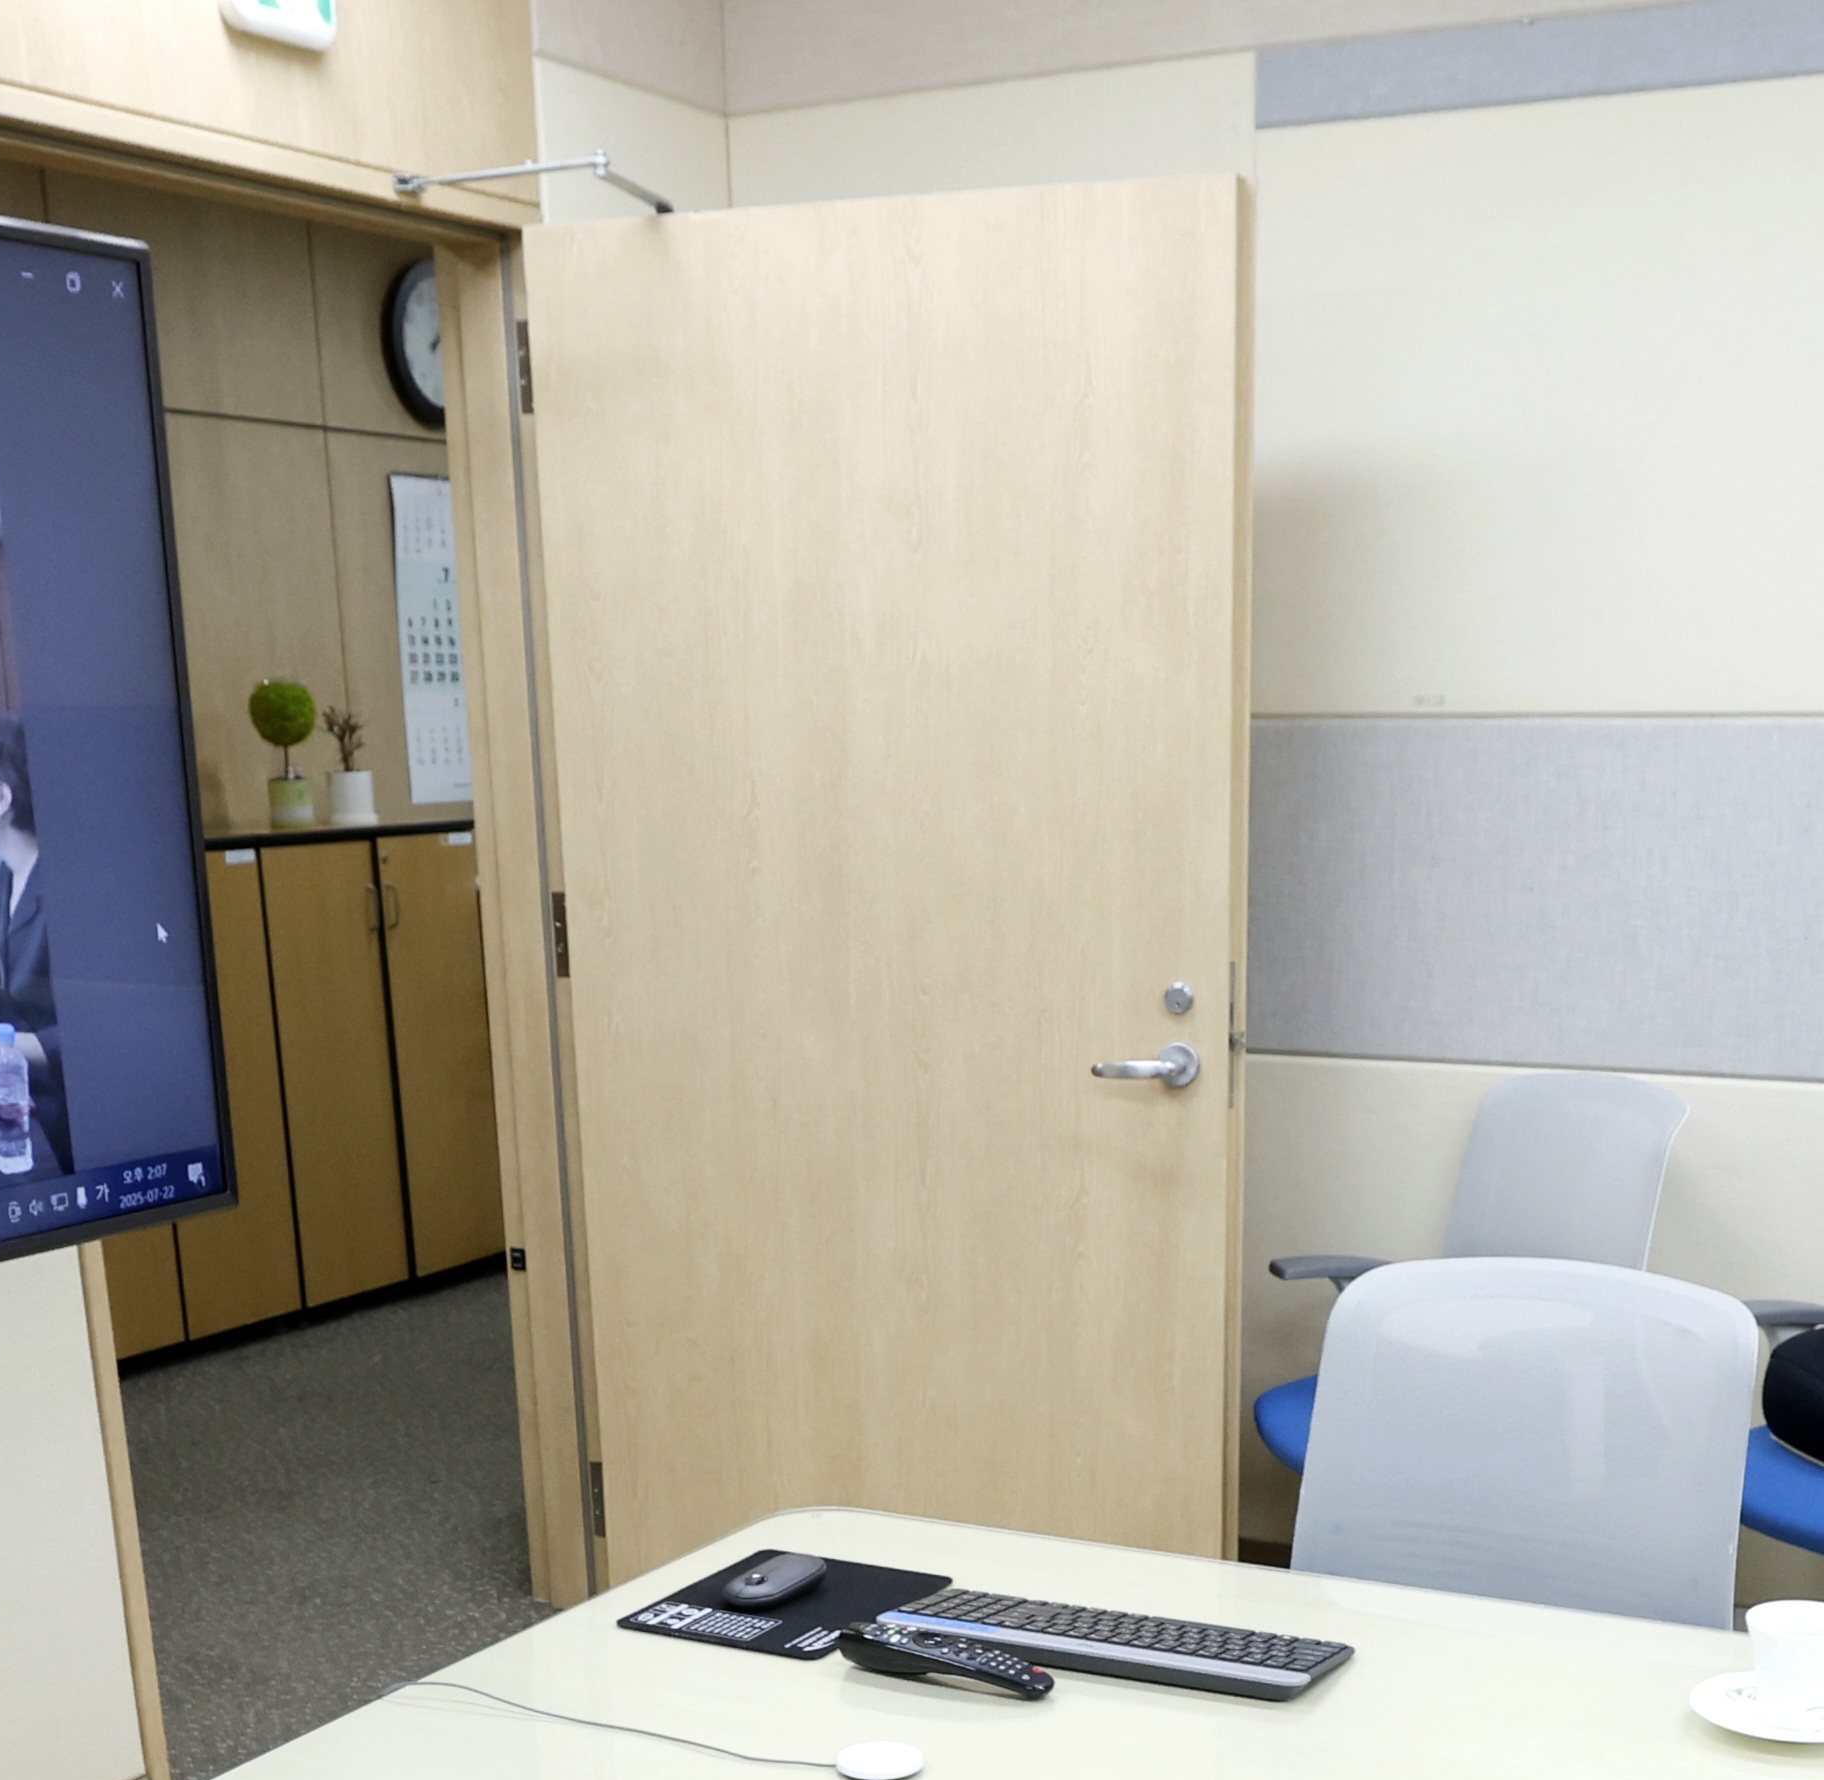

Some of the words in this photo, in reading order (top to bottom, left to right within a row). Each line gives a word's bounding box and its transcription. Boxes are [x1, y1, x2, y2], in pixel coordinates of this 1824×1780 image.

[122, 1167, 143, 1184] 오후
[146, 1163, 167, 1180] 2:07
[95, 1183, 111, 1203] 가
[119, 1184, 175, 1209] 2025-07-22
